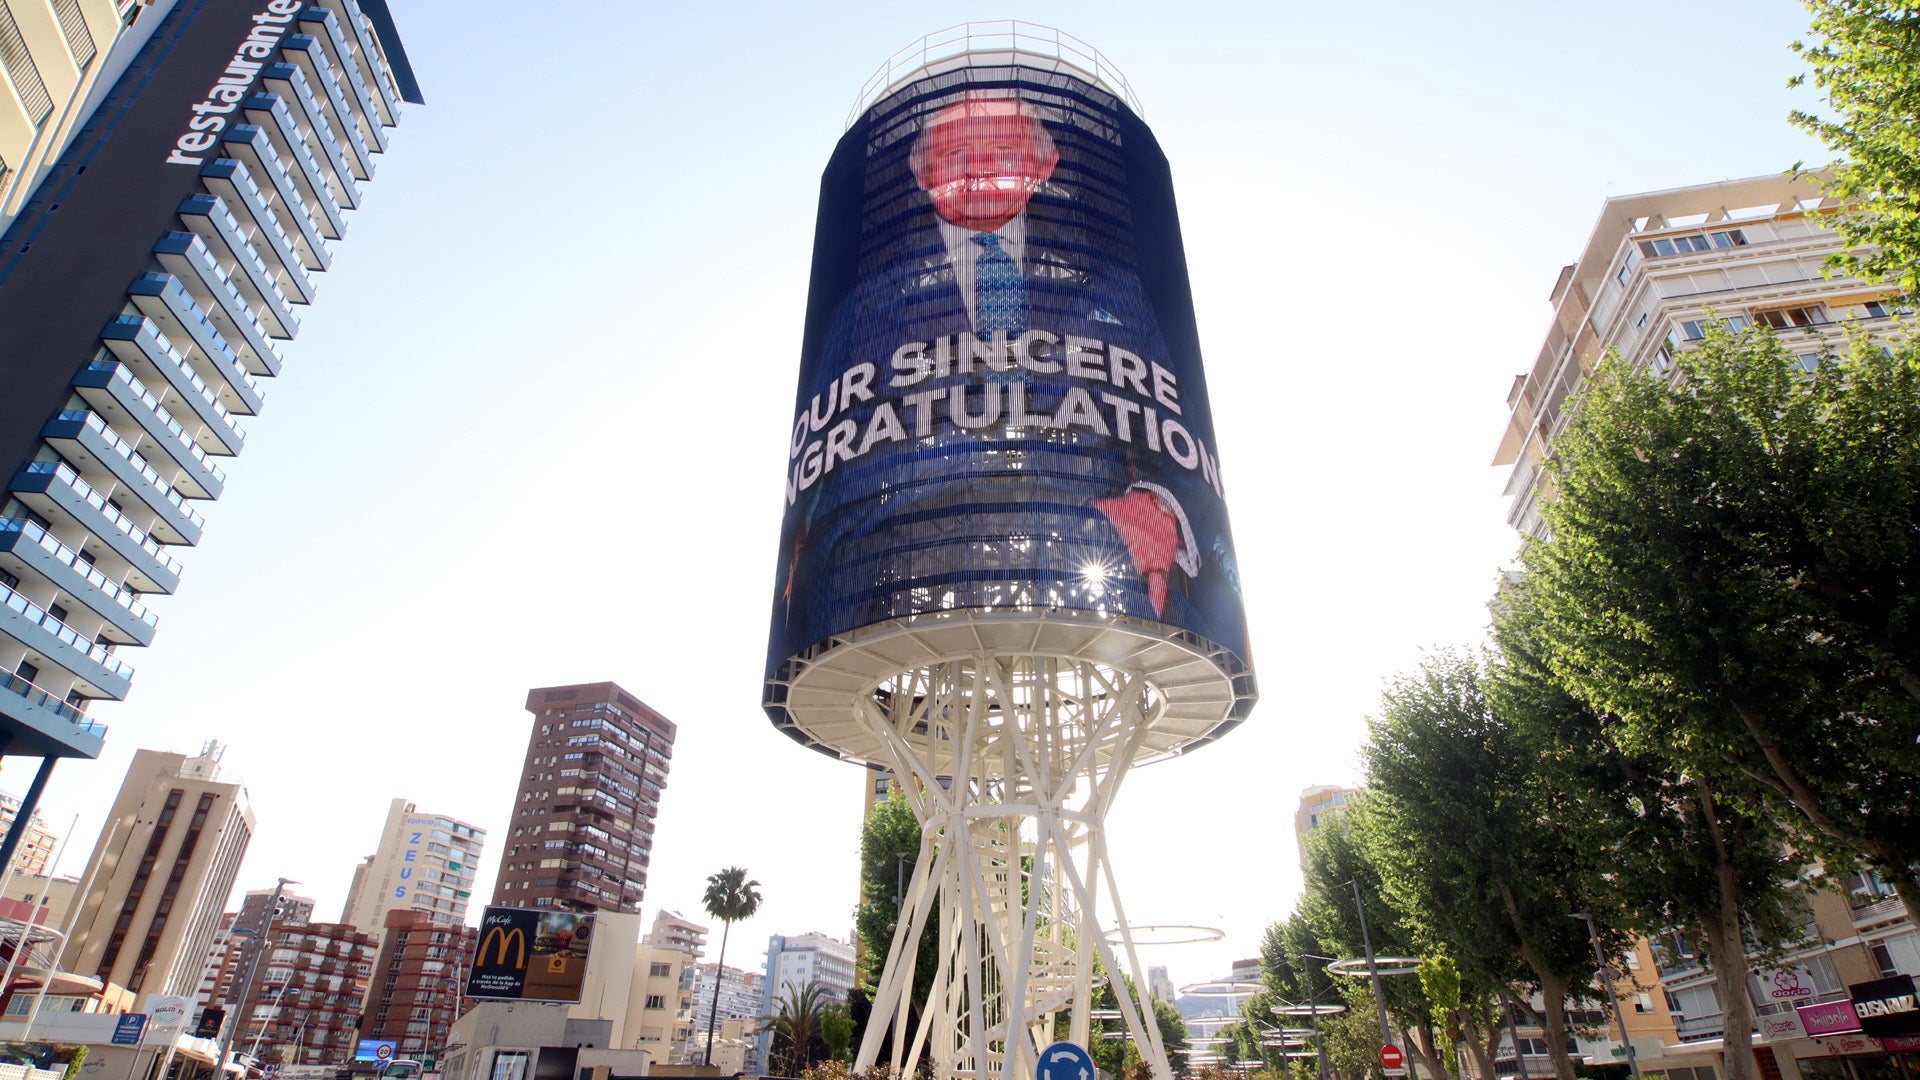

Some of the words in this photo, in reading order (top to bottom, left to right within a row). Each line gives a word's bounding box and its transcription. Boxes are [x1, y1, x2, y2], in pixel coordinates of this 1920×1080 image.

[166, 0, 302, 165] restaurante
[791, 362, 875, 459] OUR
[889, 328, 1182, 416] SINCERE
[785, 381, 1225, 507] NGRATULATION
[395, 832, 422, 898] ZEUS
[486, 915, 512, 926] McCafé
[1772, 988, 1811, 997] doria
[1854, 999, 1890, 1018] ELISA
[1885, 995, 1919, 1014] RUIZ
